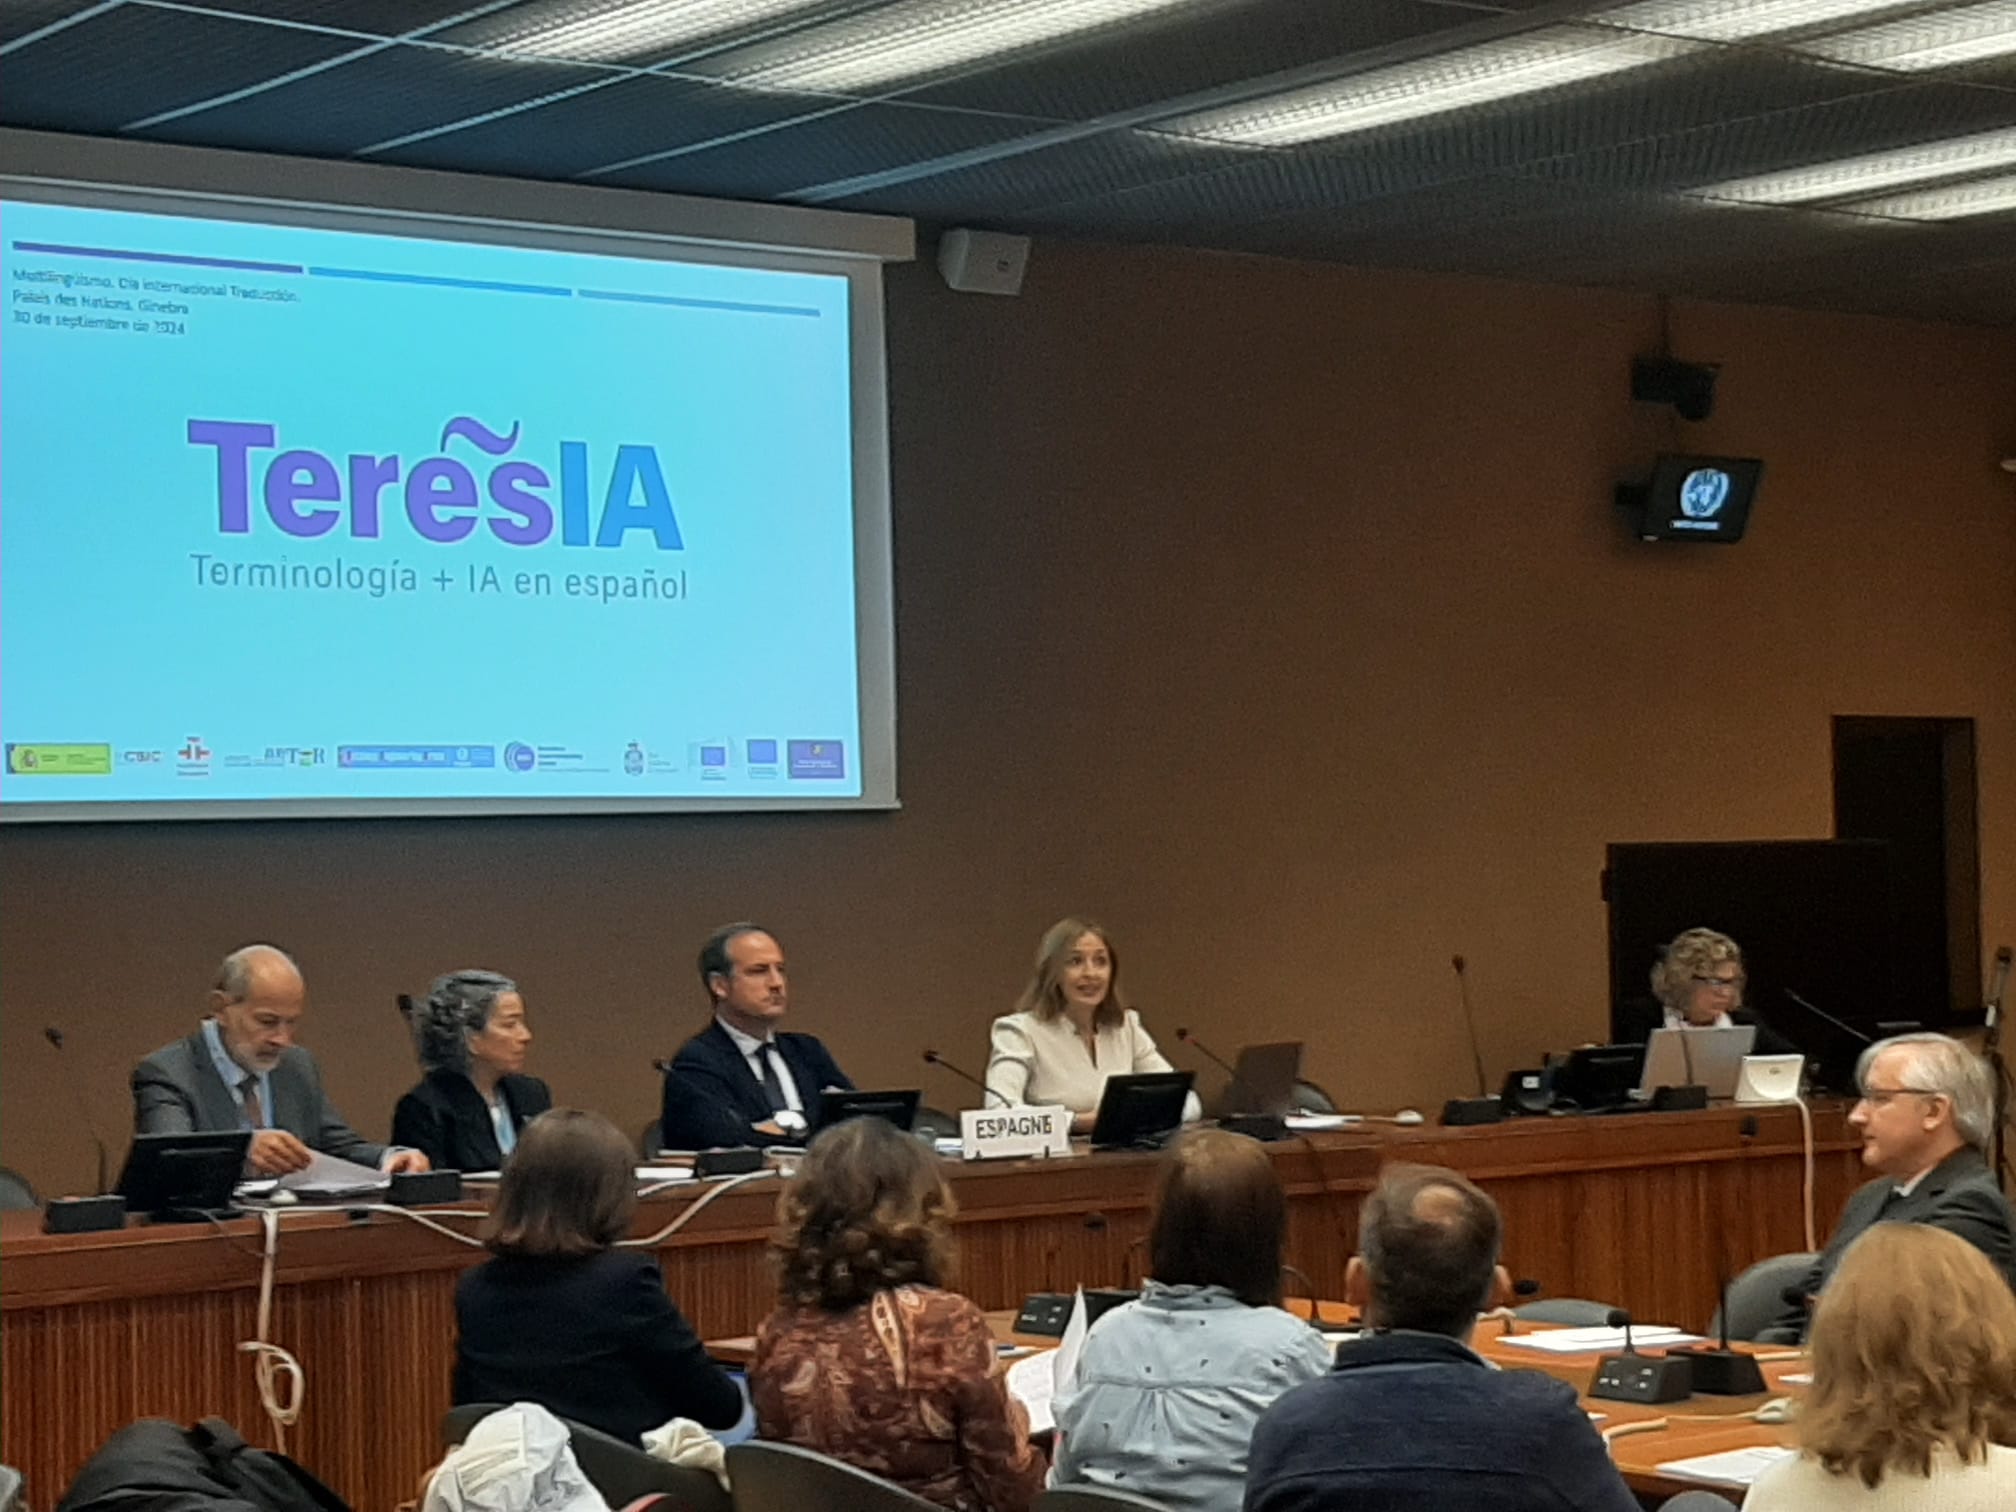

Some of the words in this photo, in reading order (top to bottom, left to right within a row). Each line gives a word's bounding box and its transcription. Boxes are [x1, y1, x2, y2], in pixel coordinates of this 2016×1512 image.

[34, 313, 51, 325] de
[190, 554, 417, 597] Terminología
[469, 564, 500, 592] IA
[515, 571, 551, 595] en
[564, 569, 687, 604] español
[975, 1114, 1052, 1139] ESPAGNE
